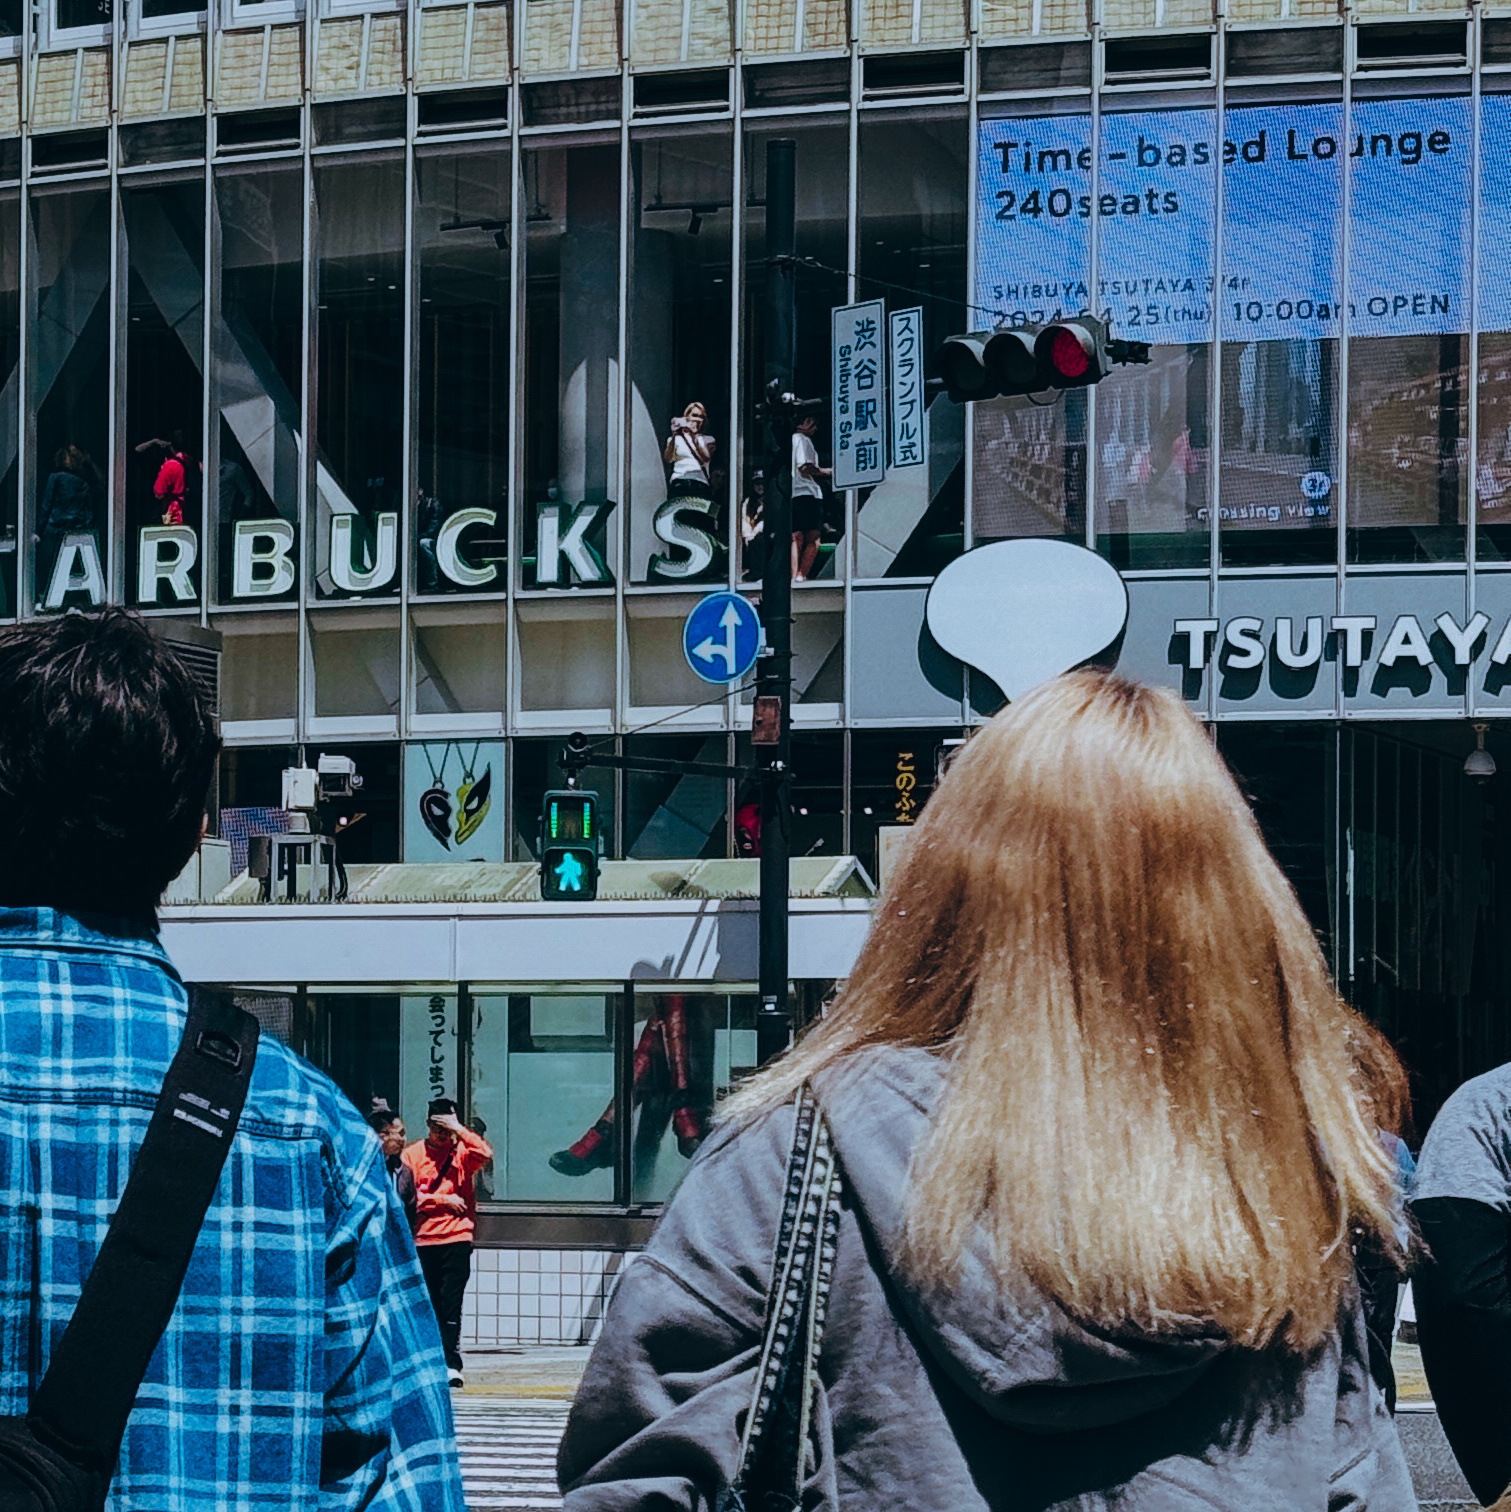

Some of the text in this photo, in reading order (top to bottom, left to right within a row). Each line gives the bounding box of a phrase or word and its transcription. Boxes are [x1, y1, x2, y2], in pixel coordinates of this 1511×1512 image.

[992, 129, 1451, 174] Time-based Lounge
[993, 188, 1180, 221] 240seats
[993, 281, 1088, 300] SHIBUYA
[1100, 275, 1196, 297] TSUTAYA
[1366, 293, 1450, 316] OPEN
[838, 344, 852, 457] Shibuya Sta.
[854, 316, 878, 473] 渋谷駅前
[897, 316, 918, 462] スクランブル式
